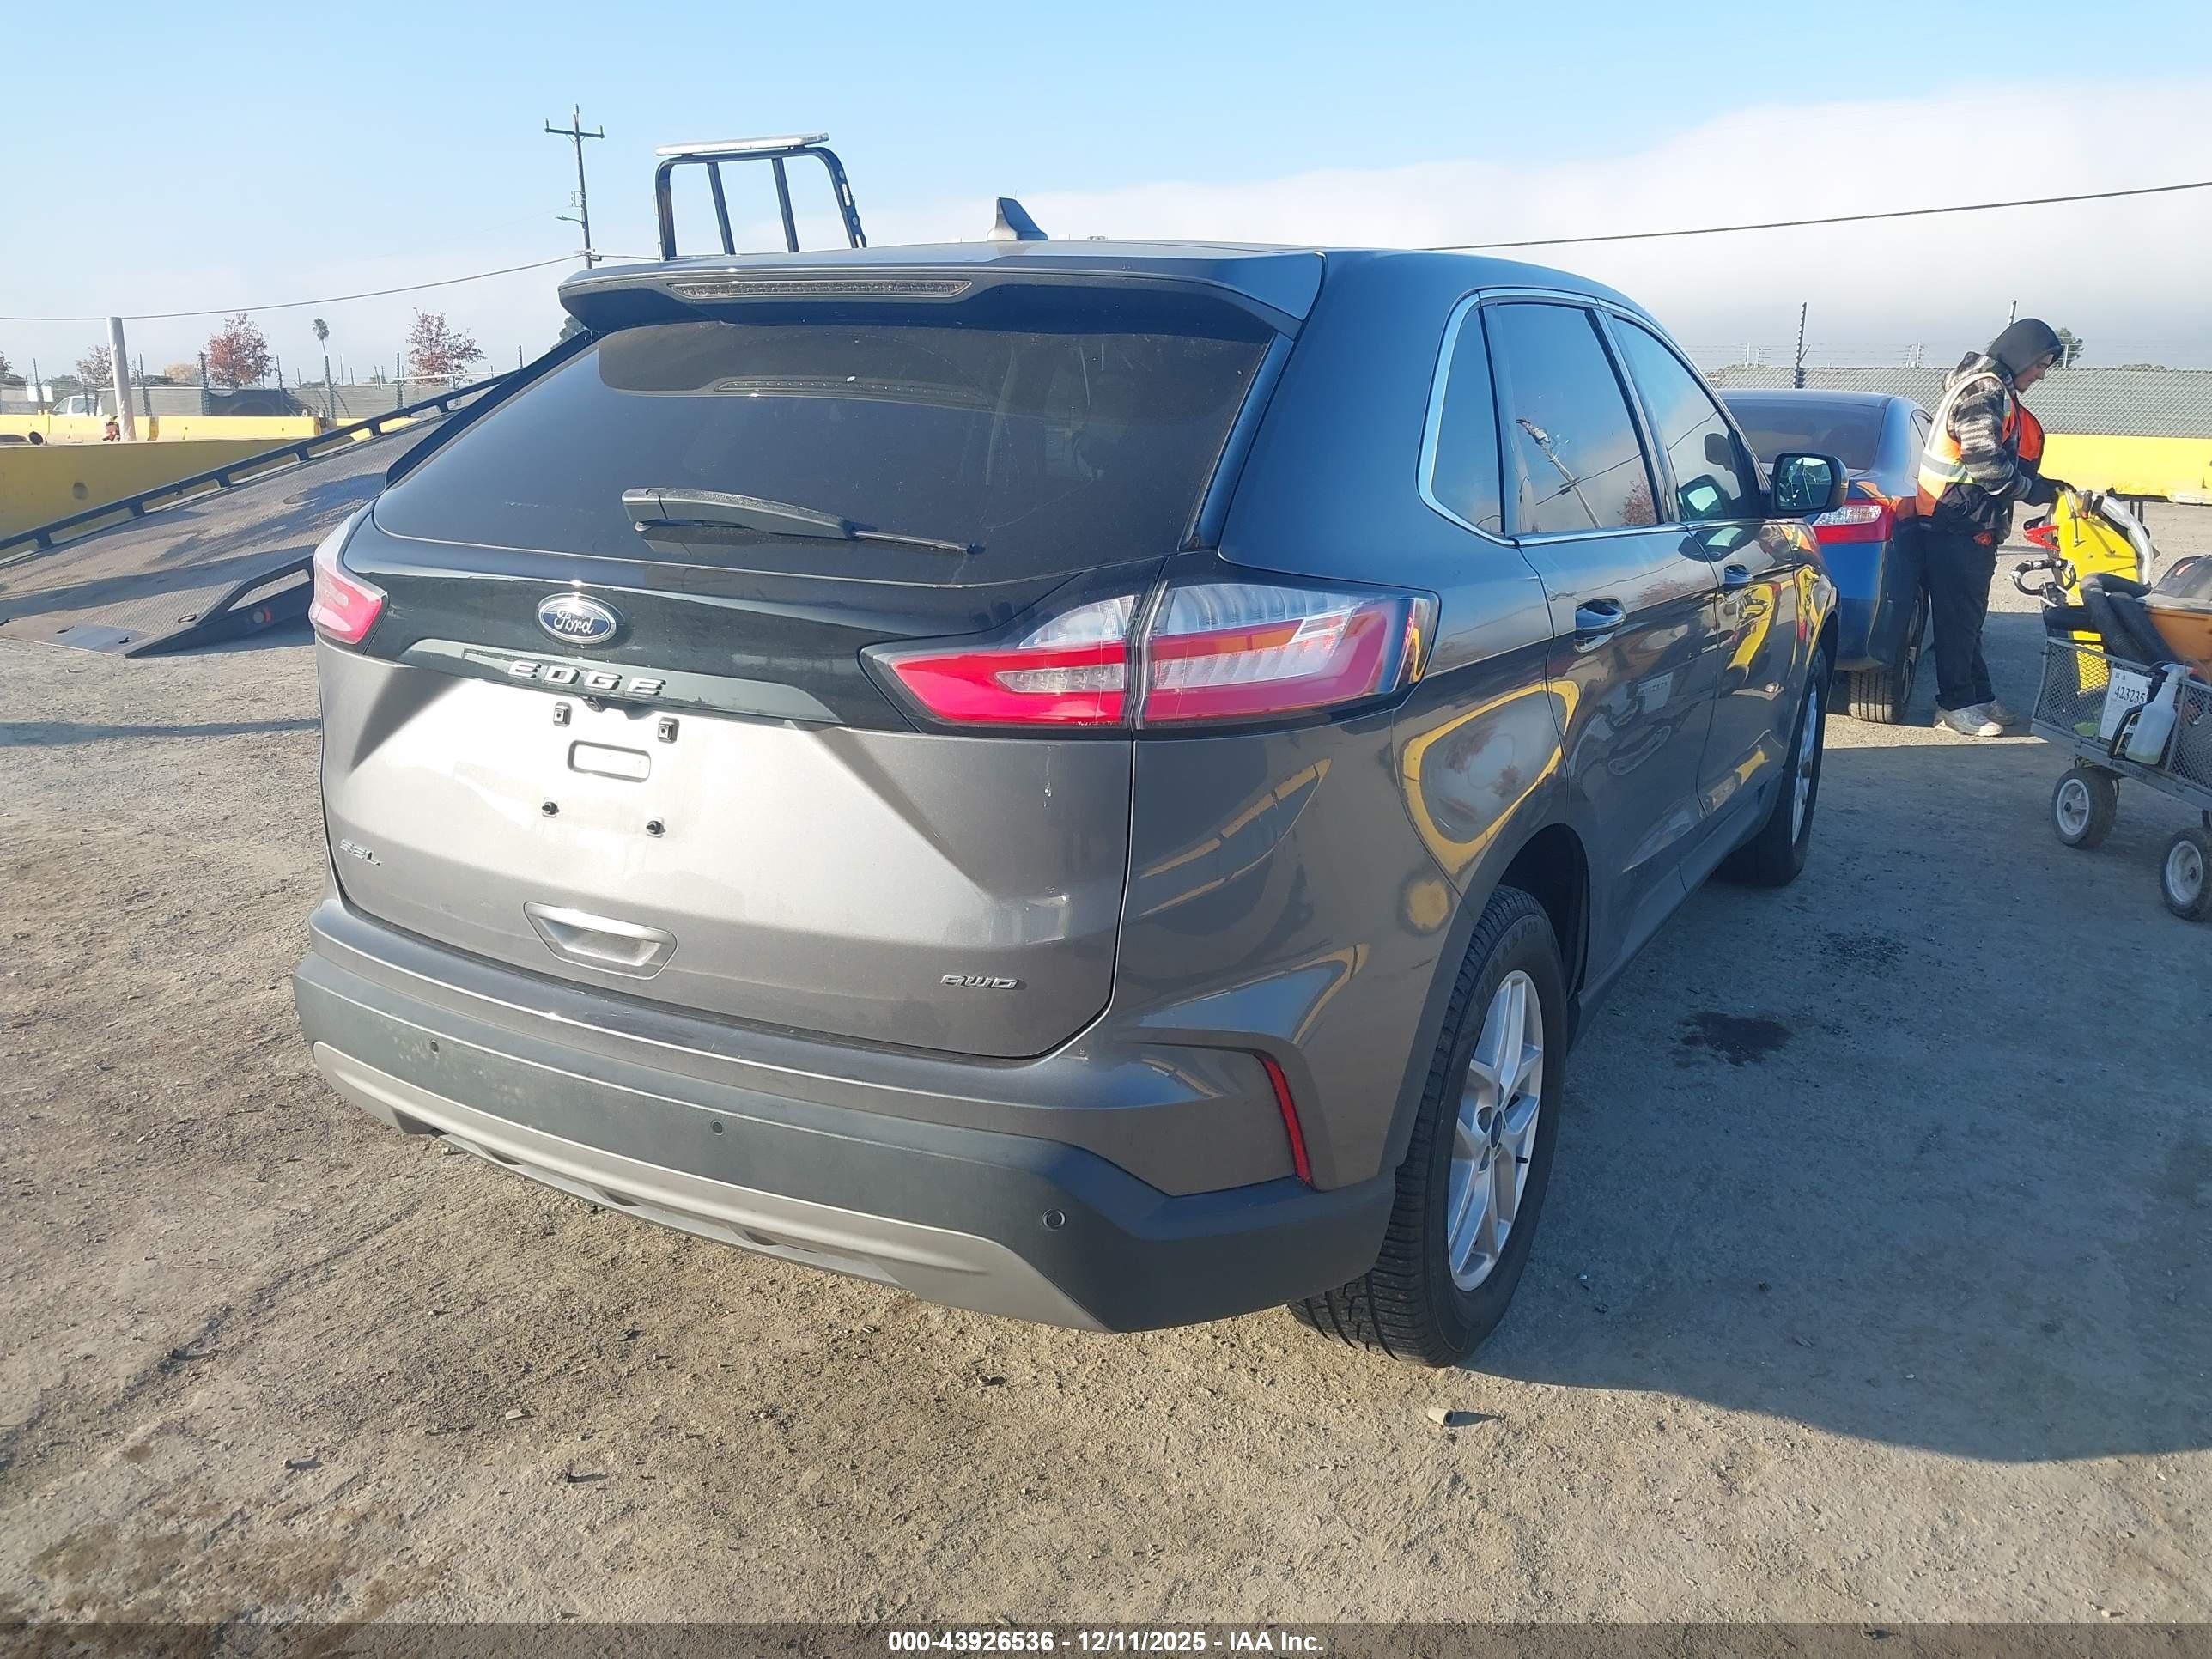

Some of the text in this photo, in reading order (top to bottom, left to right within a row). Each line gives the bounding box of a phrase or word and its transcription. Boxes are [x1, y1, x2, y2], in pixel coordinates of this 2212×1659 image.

[553, 609, 596, 635] Ford
[507, 659, 666, 696] EDGE
[339, 838, 382, 866] SEL
[940, 974, 1019, 990] AWD
